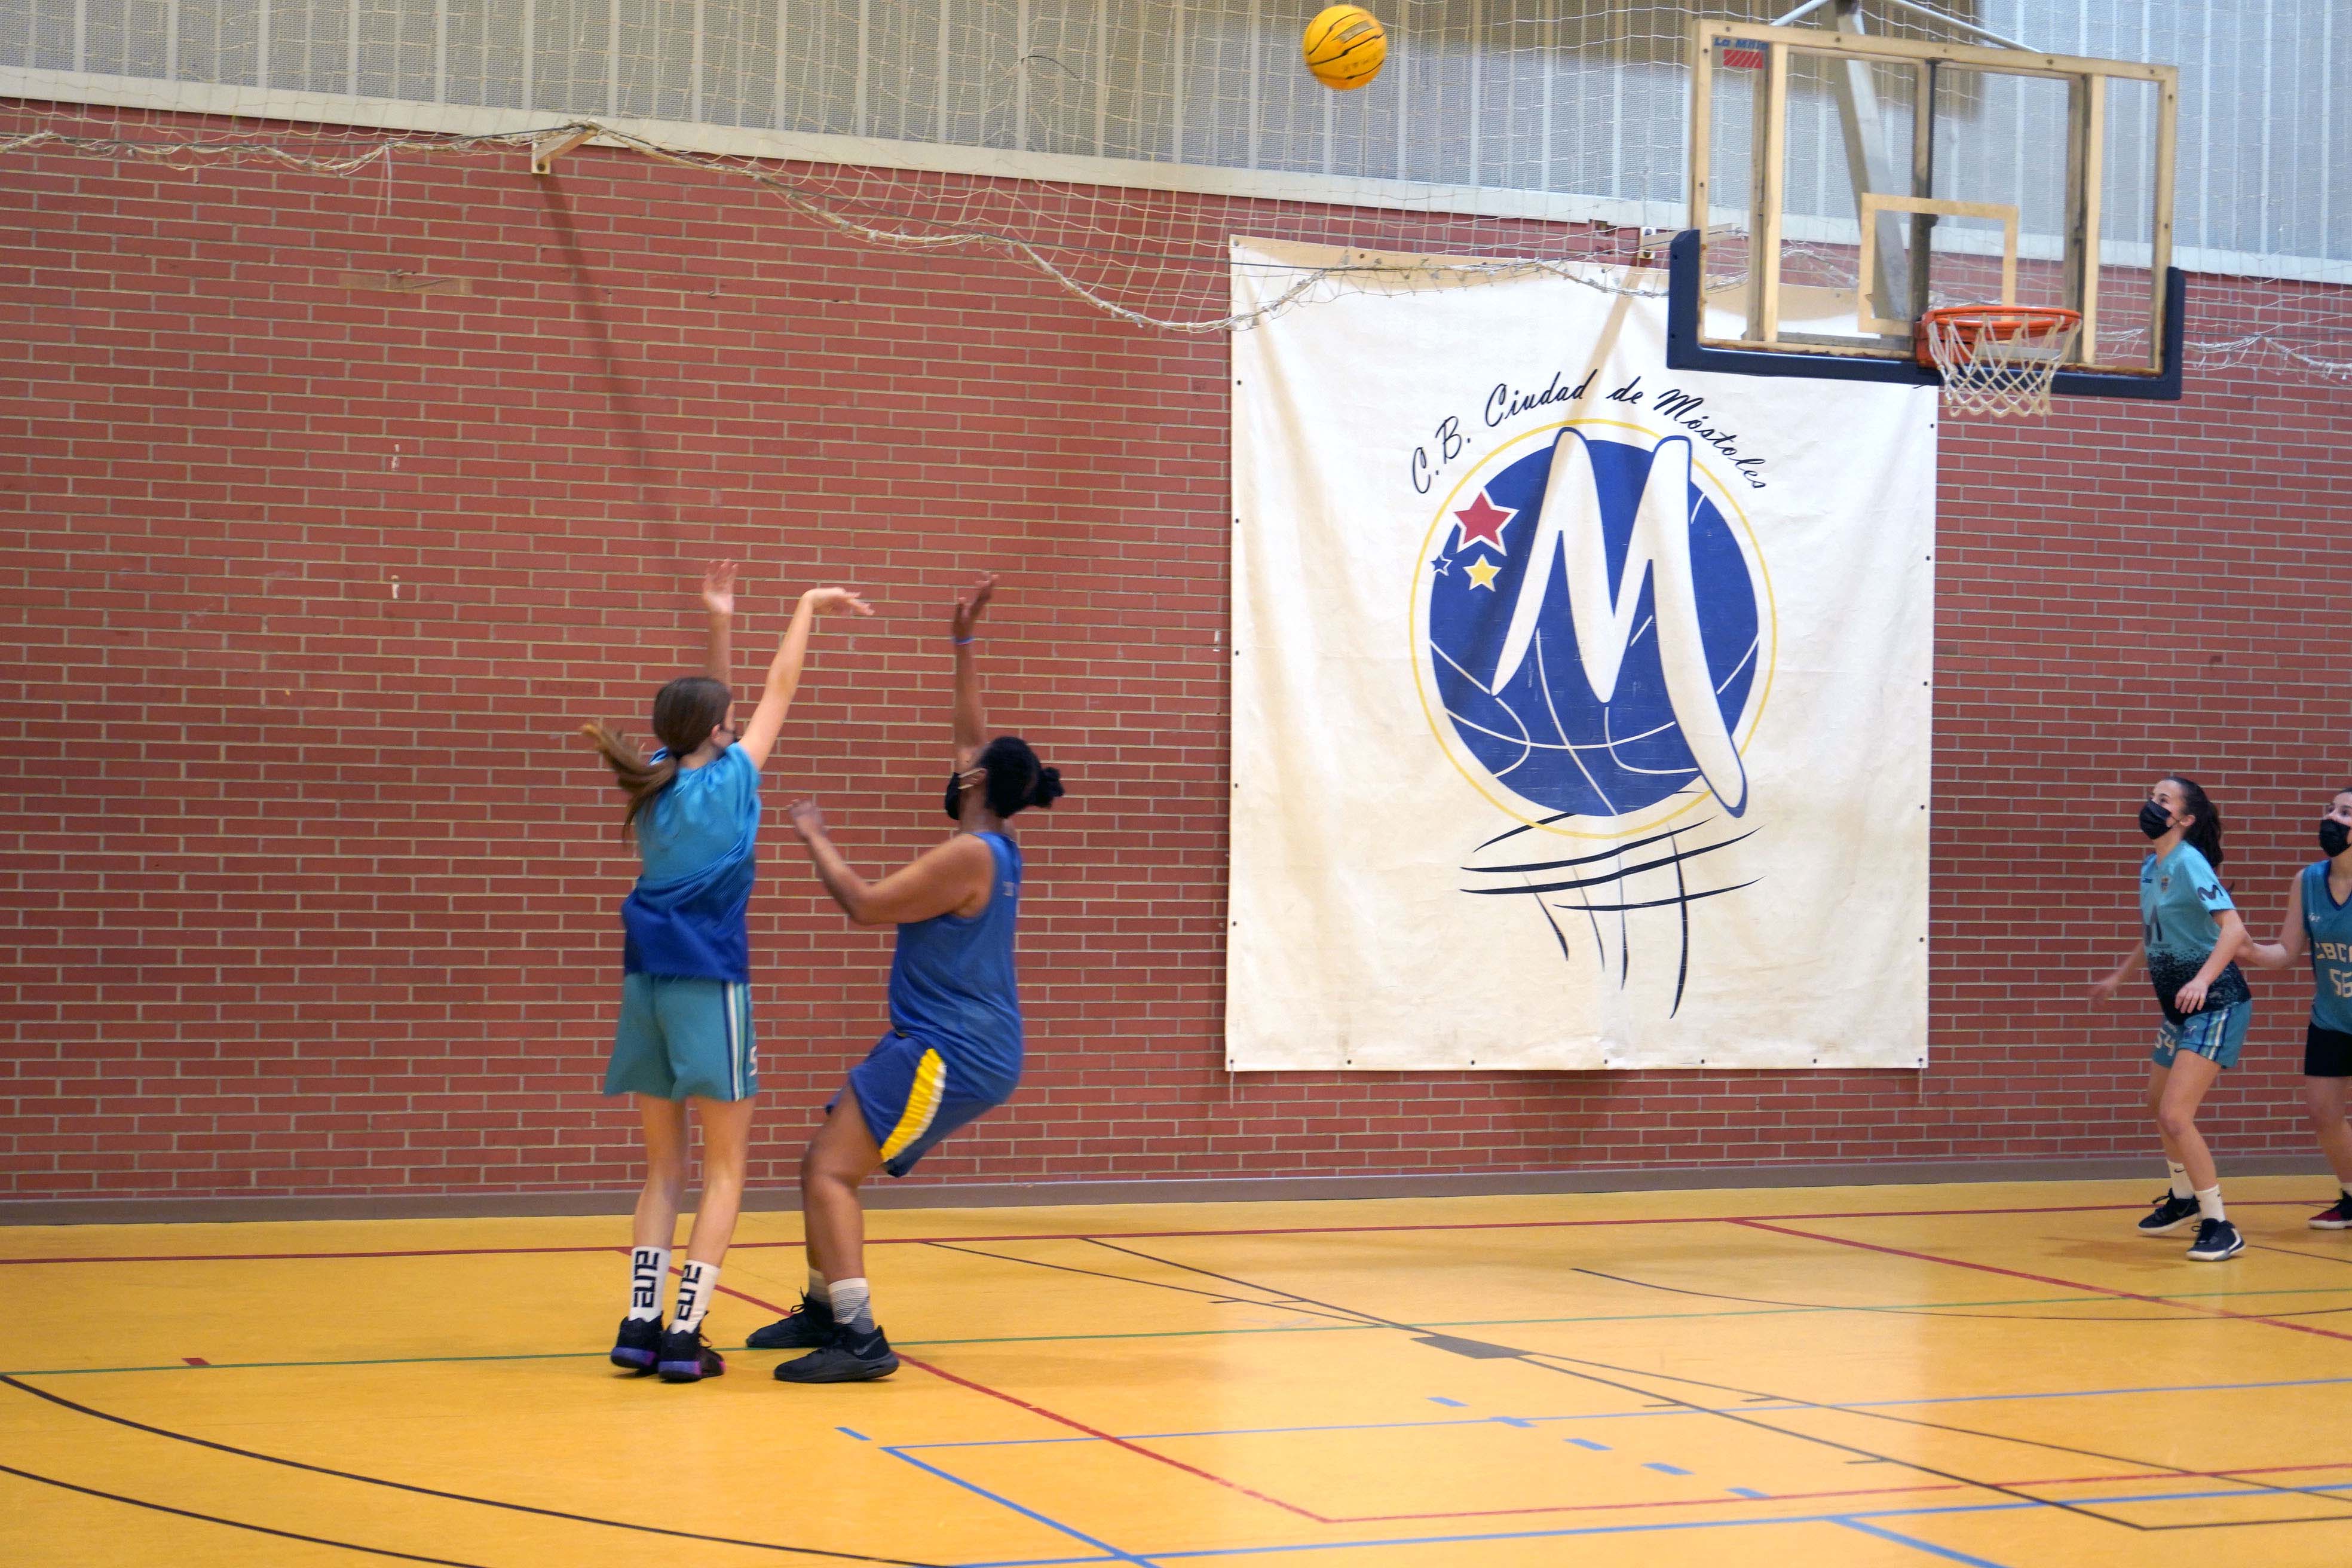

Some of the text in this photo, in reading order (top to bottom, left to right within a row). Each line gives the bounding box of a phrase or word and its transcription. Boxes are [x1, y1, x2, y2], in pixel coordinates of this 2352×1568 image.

[1485, 369, 1598, 427] Ciudad
[1606, 376, 1643, 405] de
[1654, 389, 1766, 489] Móstoles
[1490, 426, 1748, 819] M
